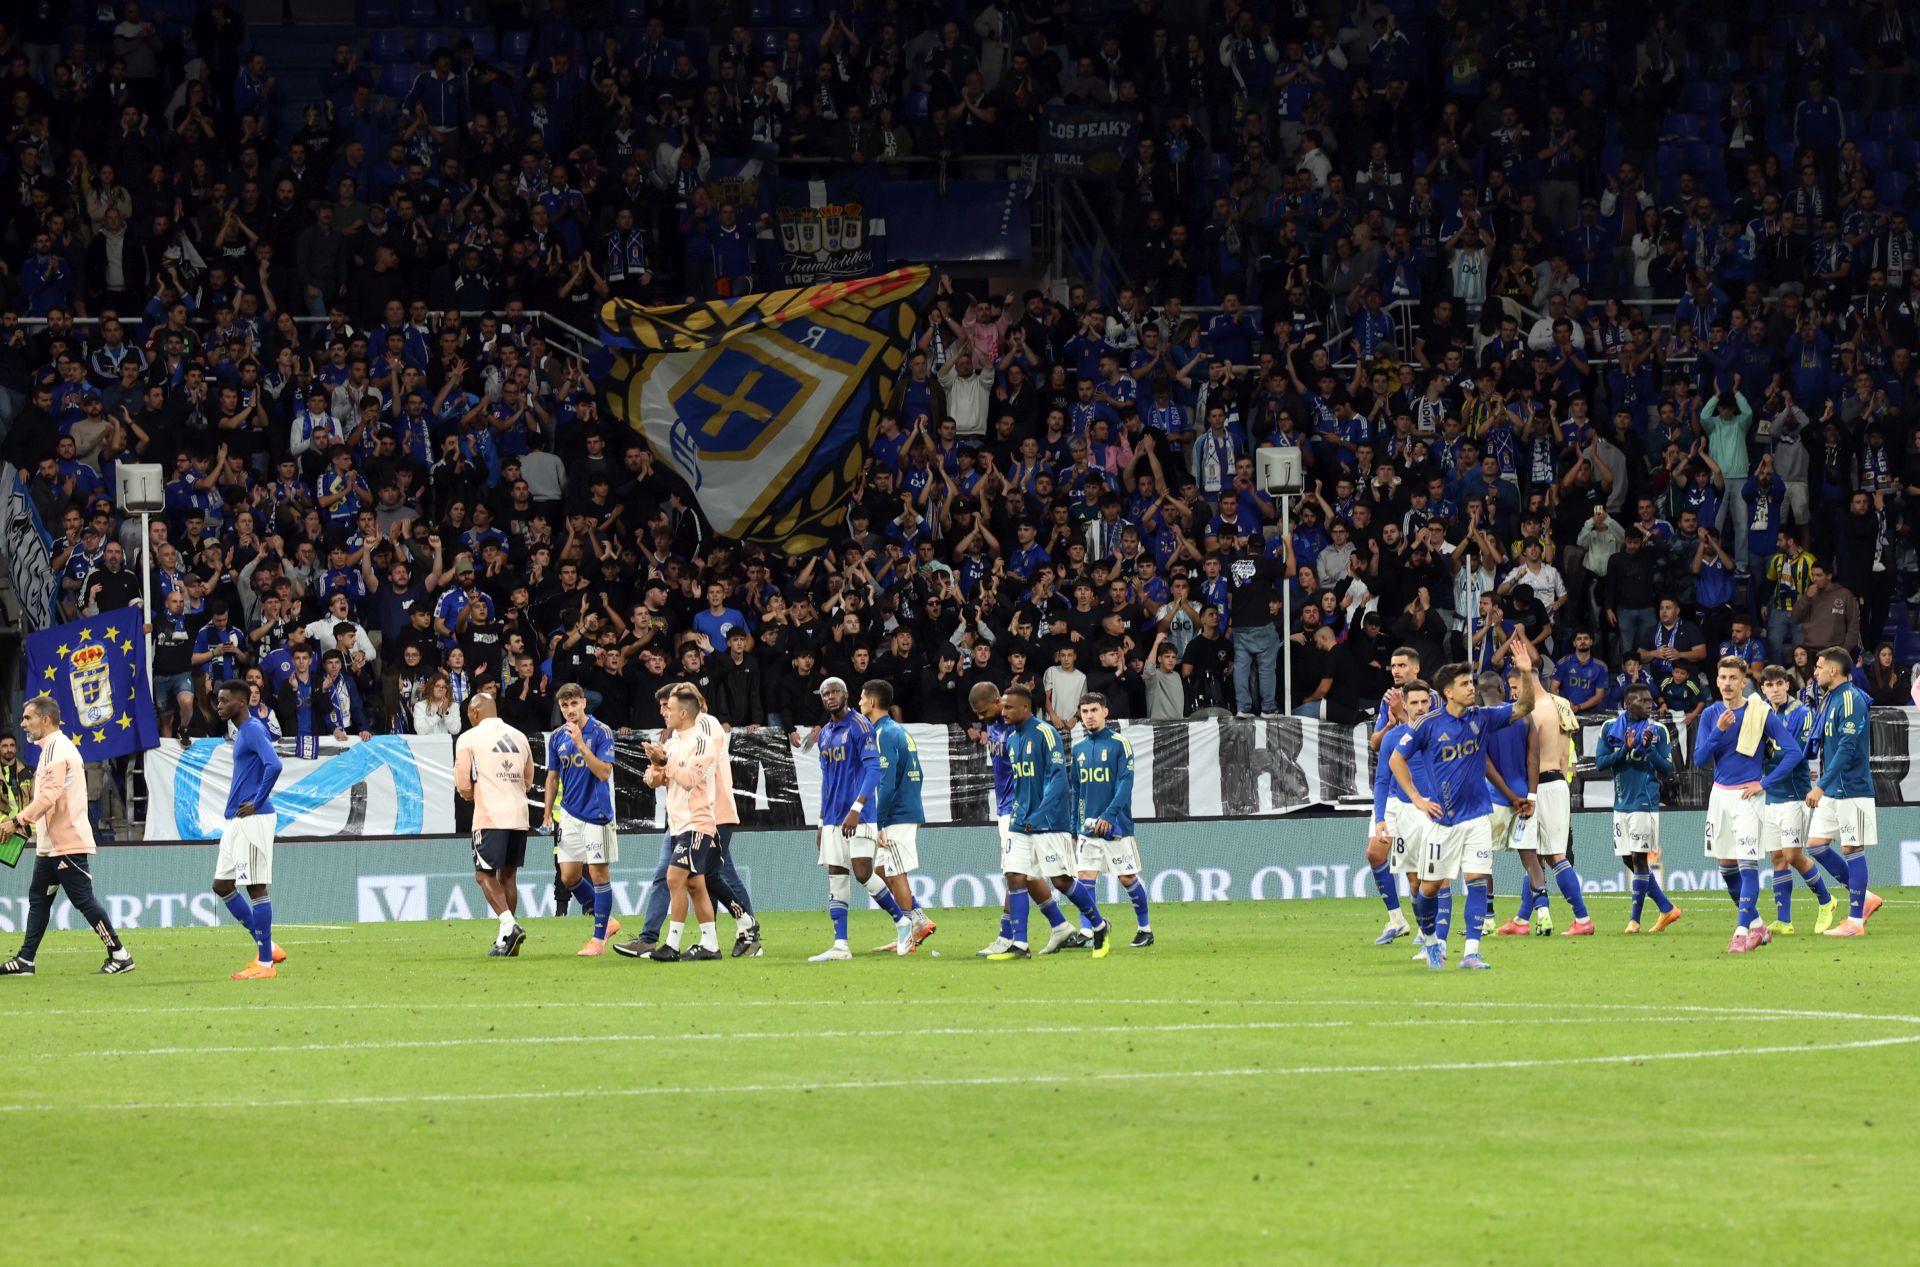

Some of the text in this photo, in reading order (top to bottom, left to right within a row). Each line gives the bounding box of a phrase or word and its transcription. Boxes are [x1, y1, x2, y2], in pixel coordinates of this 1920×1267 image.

[1048, 120, 1132, 139] LOS PEAKY
[1054, 153, 1084, 165] REAL
[1171, 621, 1192, 631] DIG
[1080, 767, 1110, 784] DIGI
[1705, 821, 1714, 838] 21
[1840, 824, 1856, 834] sfer
[1392, 836, 1405, 854] 18
[1429, 843, 1441, 860] 11
[1112, 853, 1135, 865] esfer
[1579, 870, 1624, 893] eal
